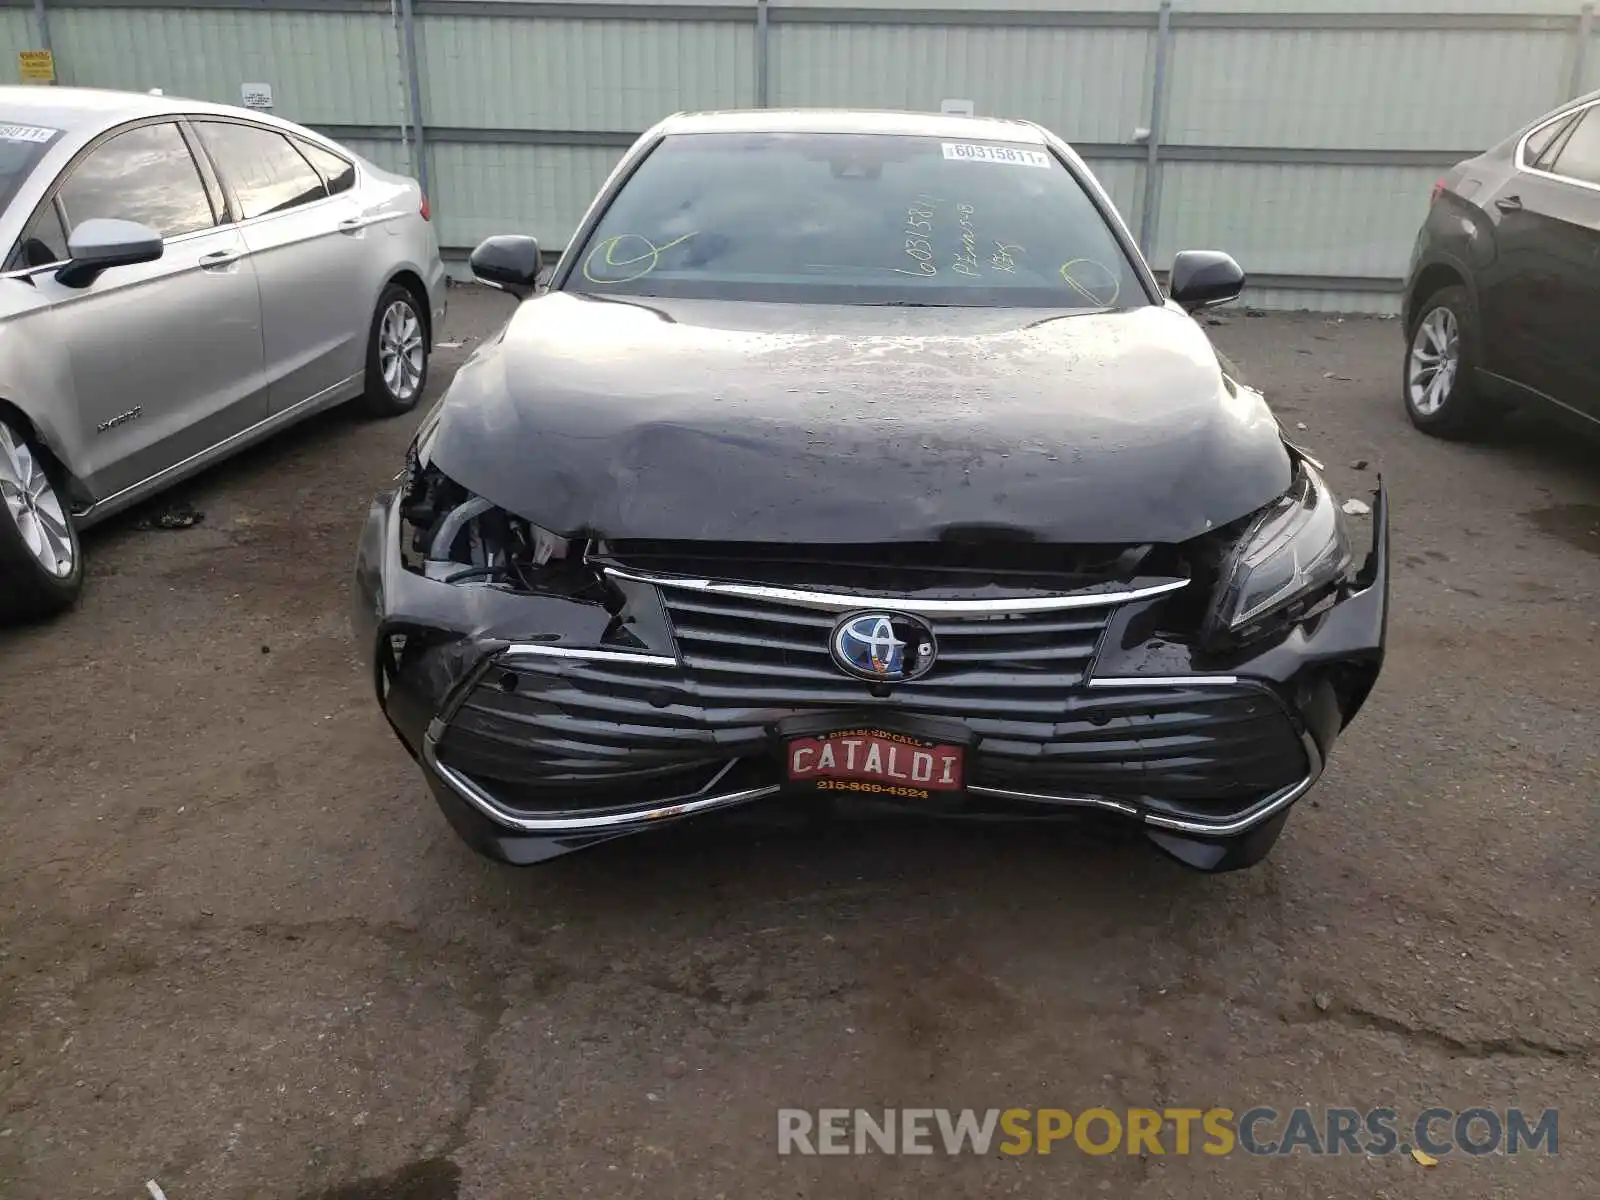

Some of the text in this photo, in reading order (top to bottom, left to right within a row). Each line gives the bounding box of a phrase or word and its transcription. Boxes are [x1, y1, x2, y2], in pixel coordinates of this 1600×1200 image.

[955, 145, 1035, 164] 60315811
[793, 740, 957, 783] CATALDI
[816, 780, 929, 799] 215-869-4524
